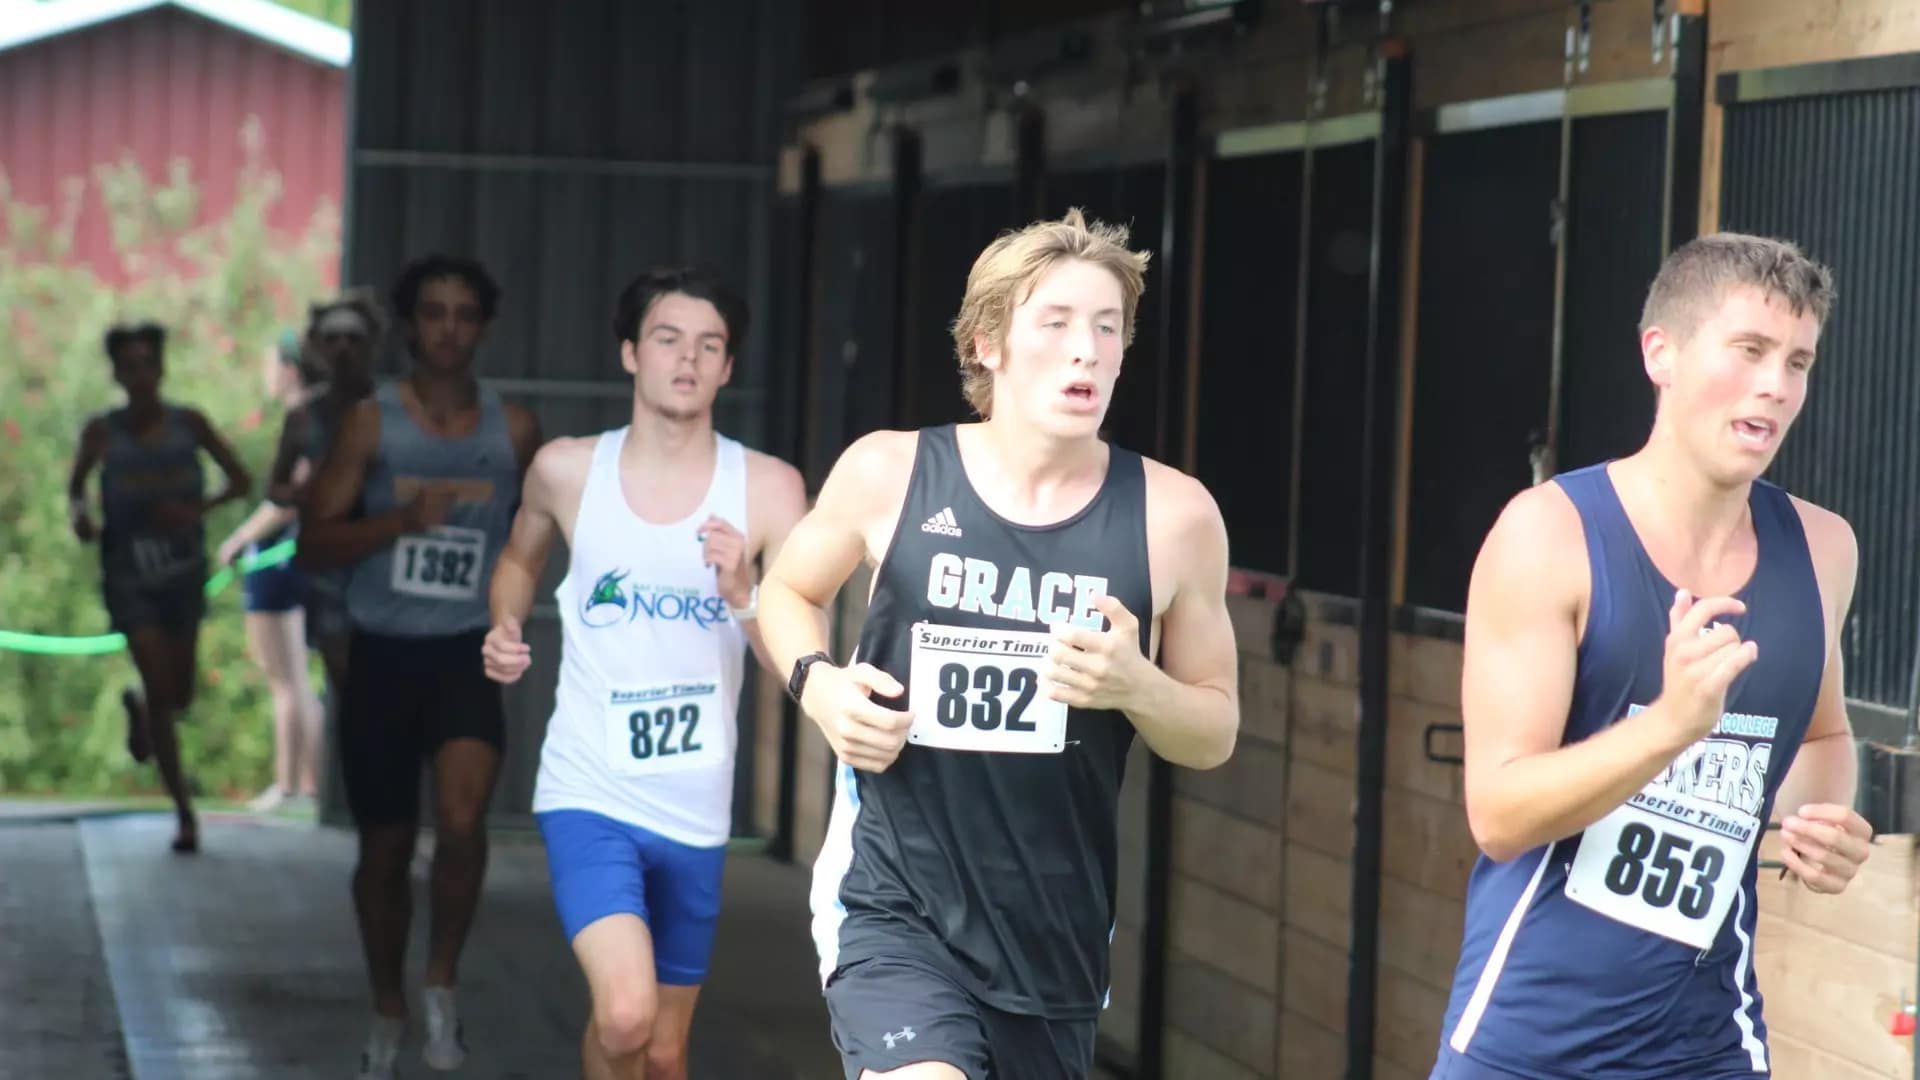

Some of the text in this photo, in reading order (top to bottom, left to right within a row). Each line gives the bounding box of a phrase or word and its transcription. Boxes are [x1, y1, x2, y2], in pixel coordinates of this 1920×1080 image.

[921, 521, 963, 537] adidas
[404, 544, 476, 588] 1392
[628, 591, 729, 630] NORSE
[927, 552, 1109, 632] GRACE
[920, 632, 1049, 654] Superior Timin
[936, 661, 1039, 732] 832
[629, 703, 703, 760] 822
[1720, 712, 1779, 739] COLLEGE
[1632, 791, 1753, 840] perior Timing
[1604, 821, 1726, 920] 853
